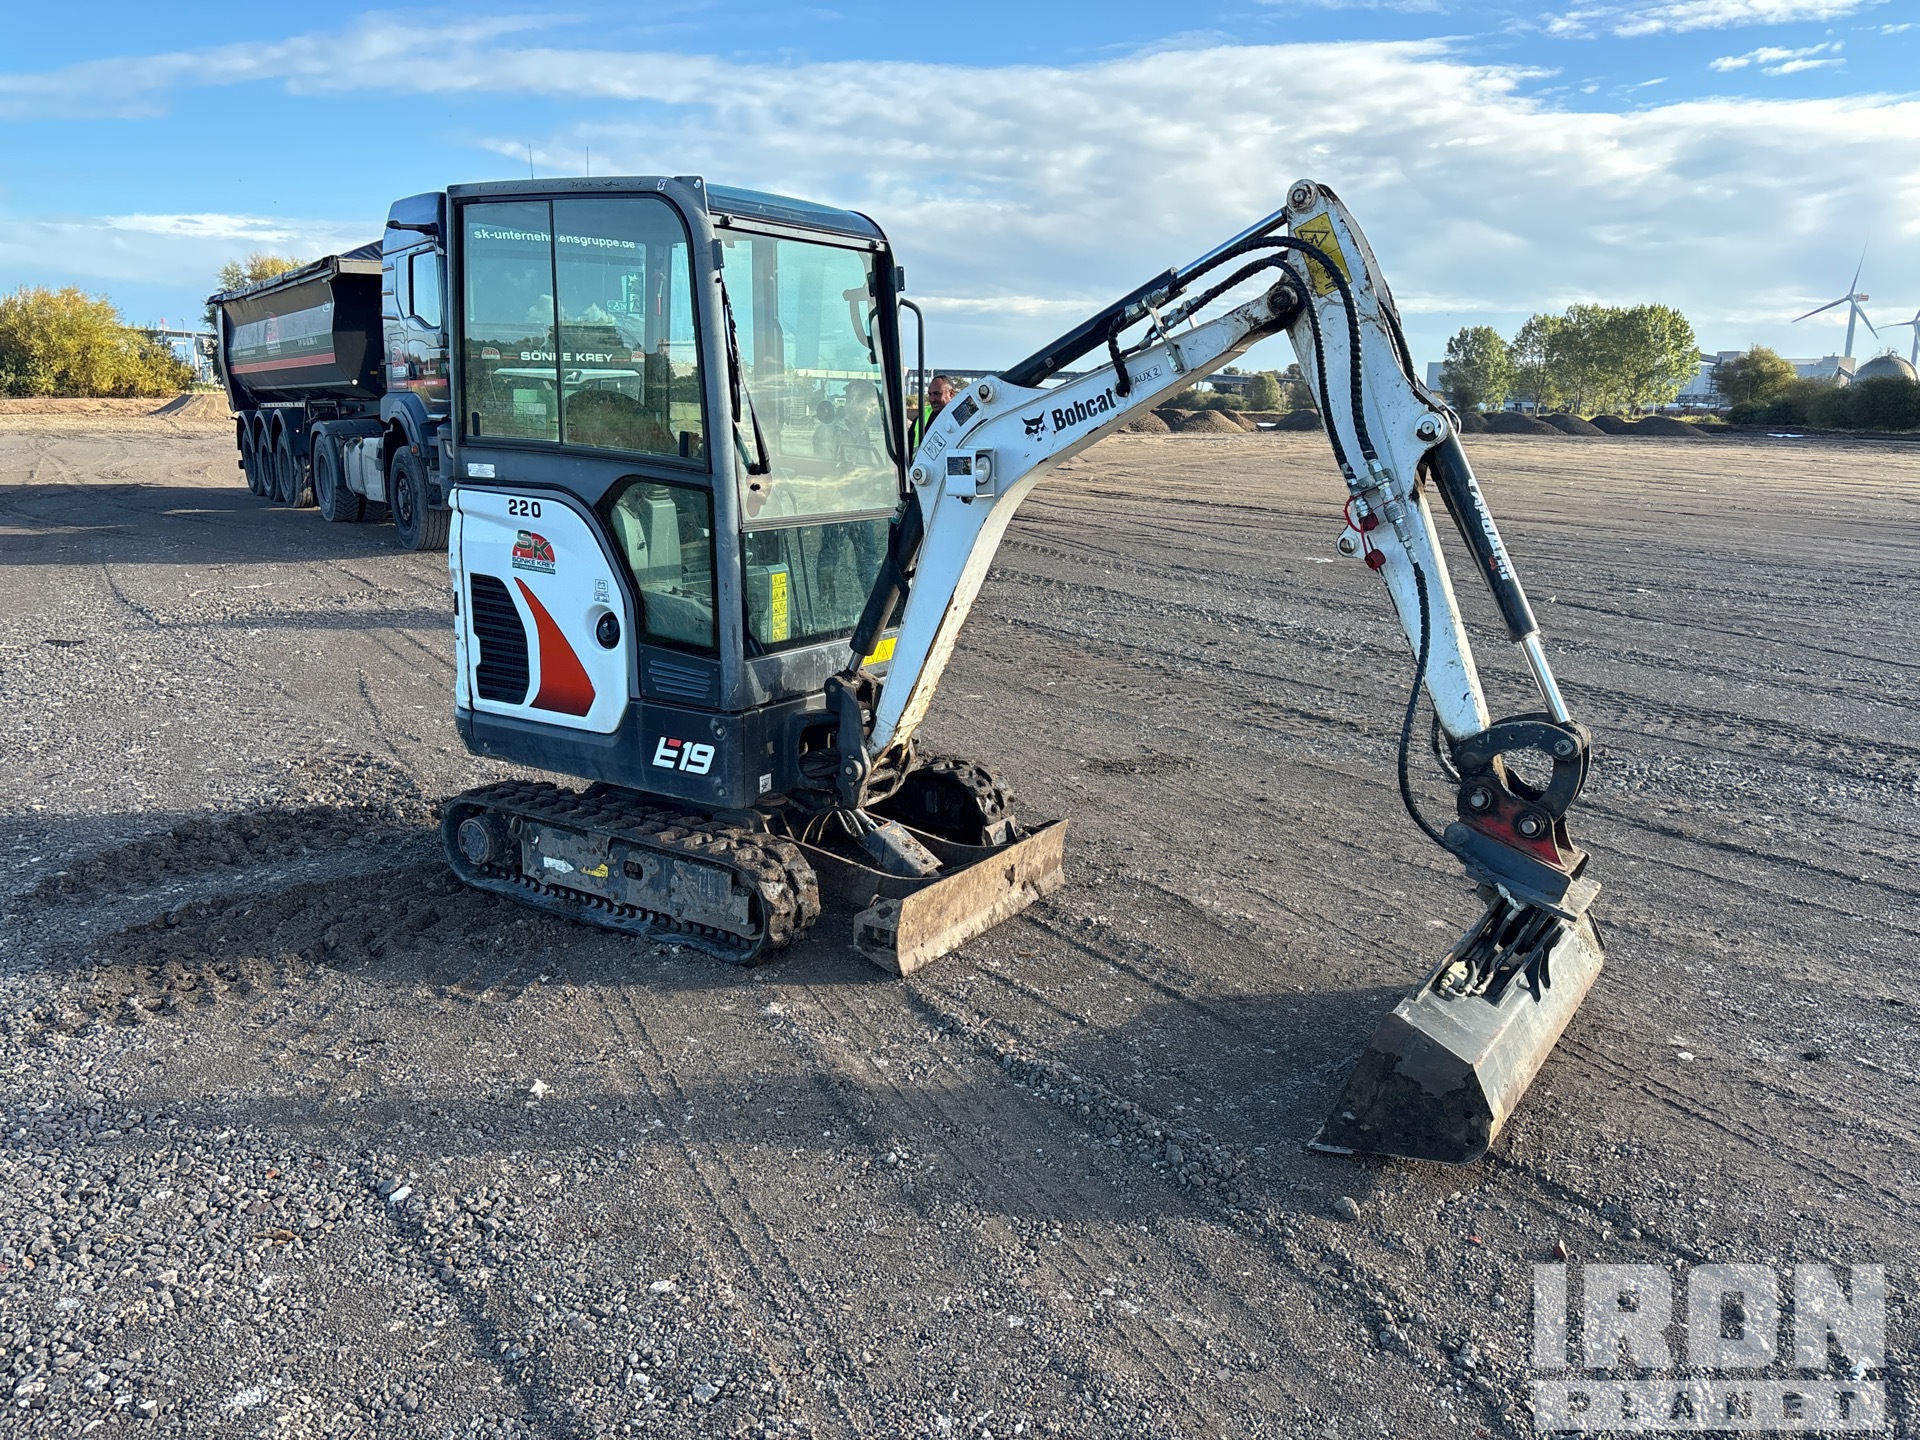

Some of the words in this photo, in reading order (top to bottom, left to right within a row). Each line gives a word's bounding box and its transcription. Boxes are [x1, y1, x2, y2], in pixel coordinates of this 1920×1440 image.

[576, 353, 613, 362] KREY
[1134, 372, 1153, 385] AUX
[1153, 367, 1160, 377] 2
[1051, 387, 1117, 432] Bobcat
[508, 499, 542, 518] 220
[652, 736, 716, 775] E19
